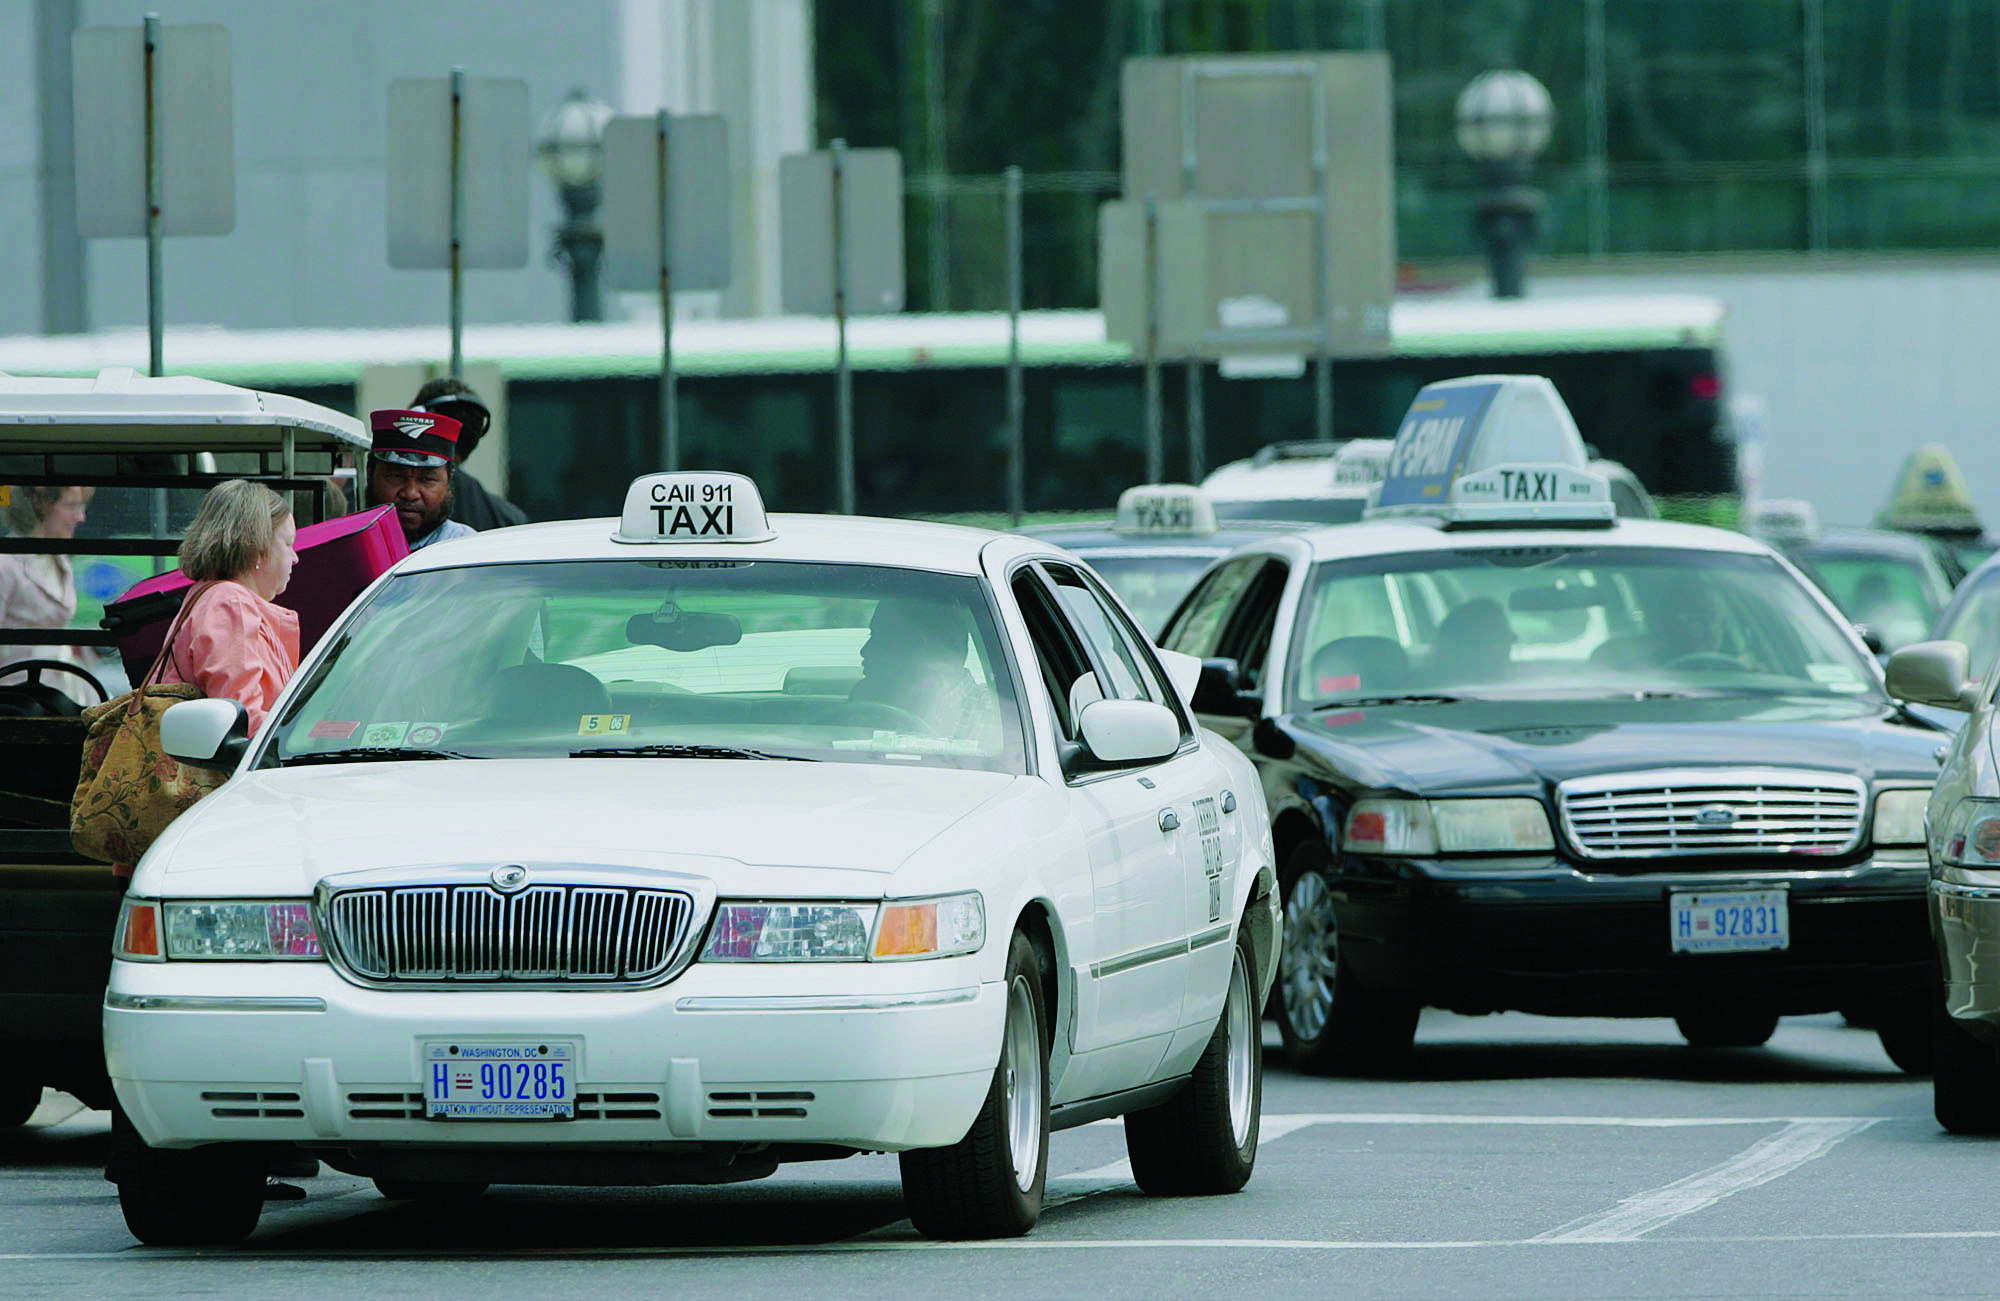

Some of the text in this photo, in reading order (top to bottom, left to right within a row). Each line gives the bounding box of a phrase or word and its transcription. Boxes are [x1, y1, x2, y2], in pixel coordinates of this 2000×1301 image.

[702, 484, 732, 503] 911
[1500, 471, 1556, 501] TAXI
[650, 505, 733, 535] TAXI
[1135, 506, 1193, 528] TAXI
[589, 717, 598, 729] 5
[1679, 906, 1778, 937] H 92831
[461, 1048, 537, 1059] WASHINGTON, DC
[433, 1063, 565, 1099] H 90285
[431, 1104, 571, 1114] TAXATION WITHOUT REPRESENTATION
